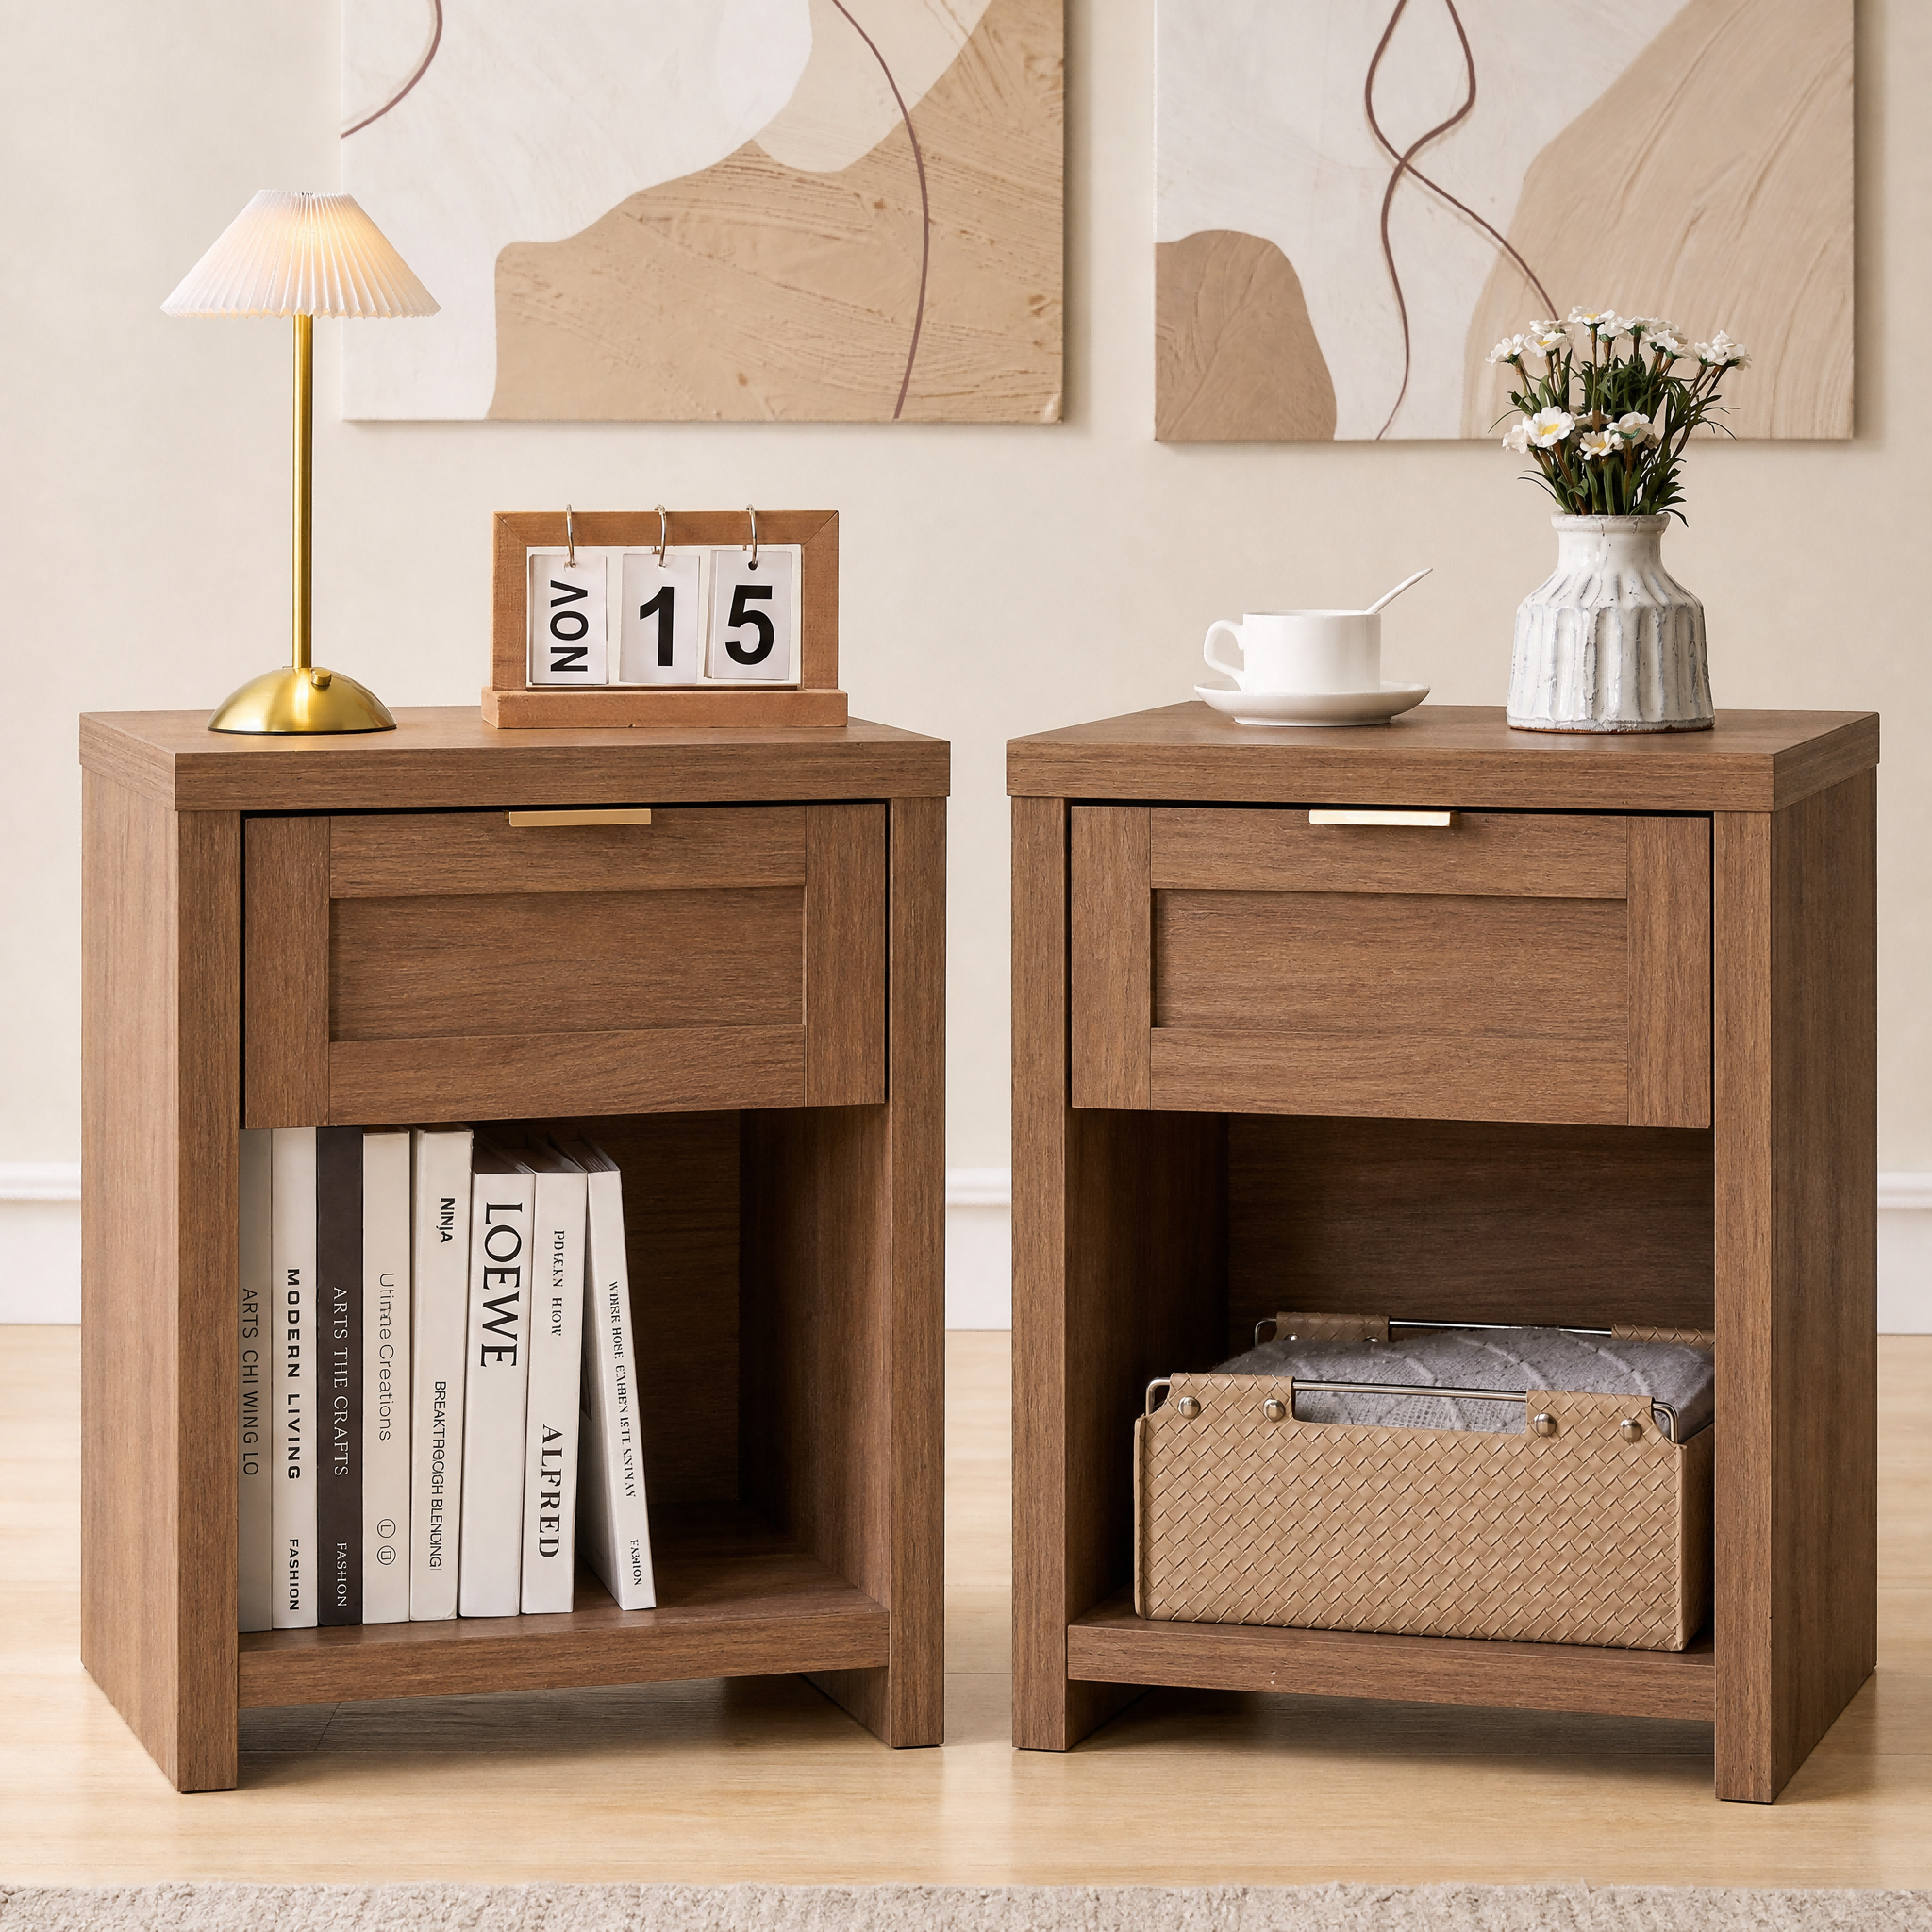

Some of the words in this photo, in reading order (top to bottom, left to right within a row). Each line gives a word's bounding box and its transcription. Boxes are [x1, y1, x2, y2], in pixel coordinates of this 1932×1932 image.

[550, 580, 589, 672] NOV
[437, 1197, 456, 1243] NINJA
[242, 1288, 258, 1339] ARTS
[333, 1286, 349, 1340] ARTS
[480, 1201, 524, 1368] LOEWE
[287, 1268, 301, 1378] MODERN
[242, 1349, 258, 1384] CHI
[333, 1346, 349, 1390] THE
[378, 1344, 395, 1441] Creations
[242, 1391, 258, 1444] WING
[287, 1393, 301, 1480] LIVING
[333, 1395, 349, 1477] CRAFTS
[242, 1452, 259, 1476] LO
[538, 1424, 564, 1558] ALFRED
[289, 1538, 300, 1611] FASHION
[336, 1542, 347, 1607] FASHION
